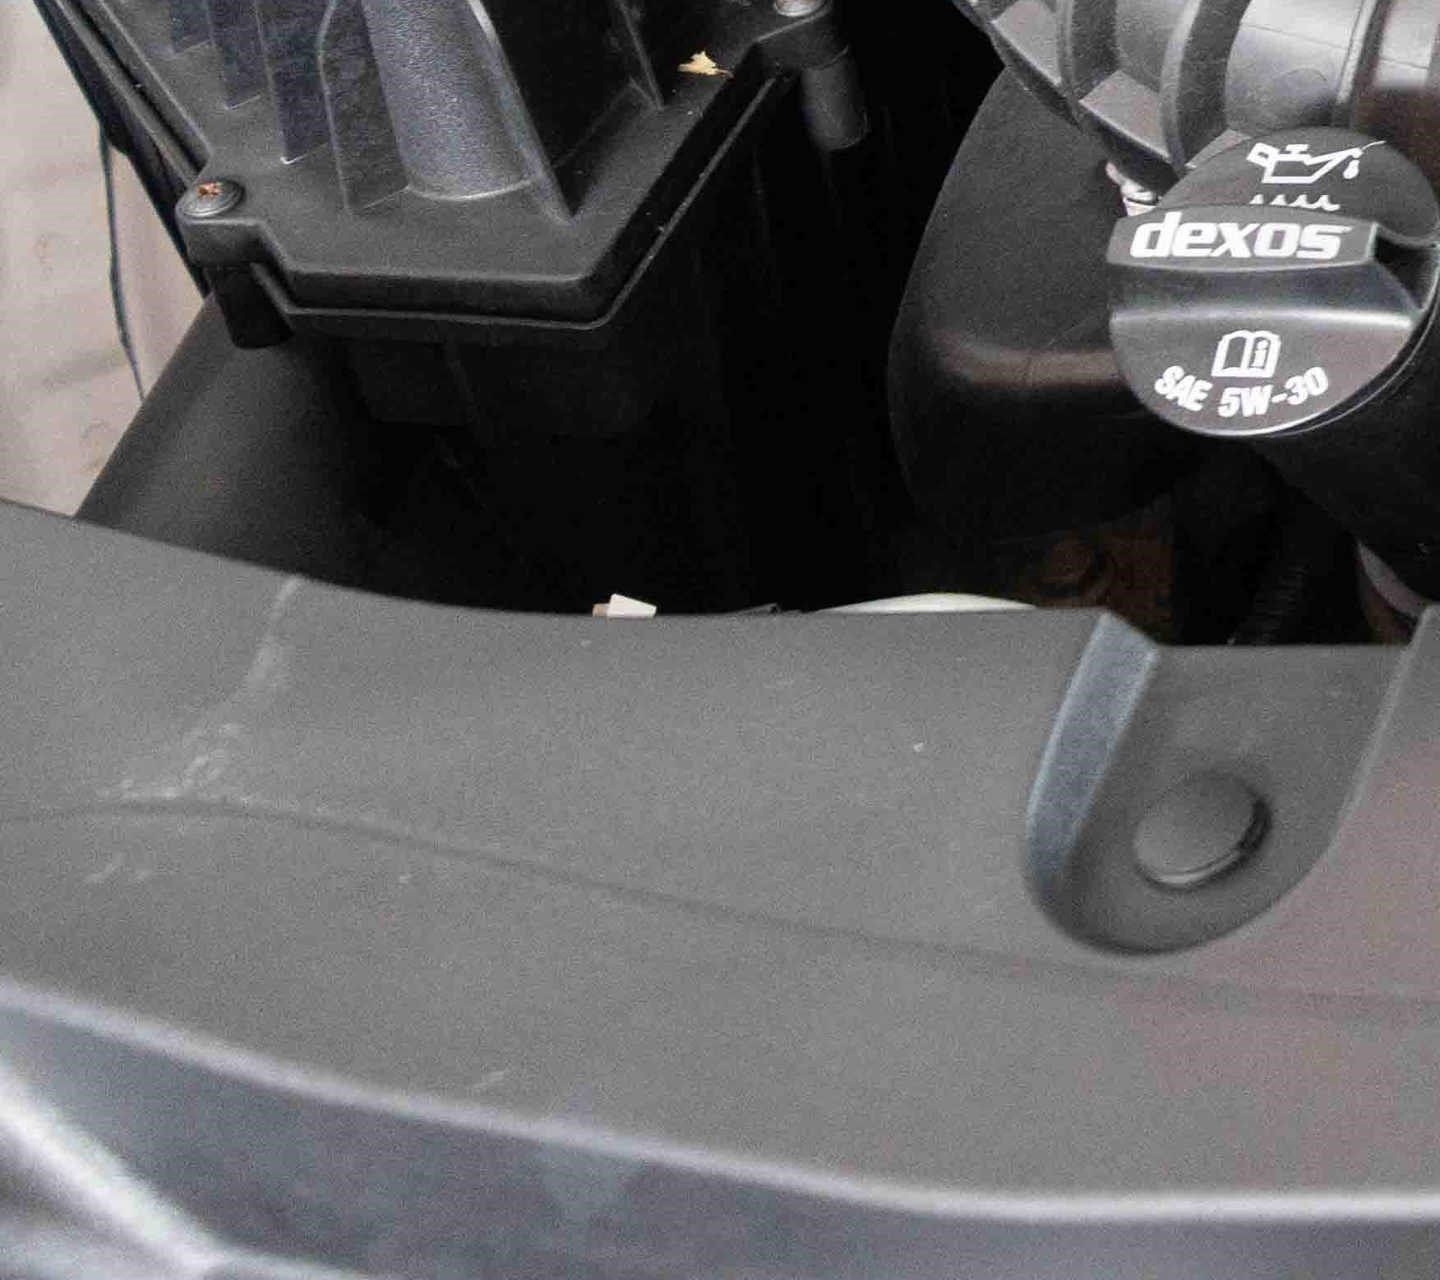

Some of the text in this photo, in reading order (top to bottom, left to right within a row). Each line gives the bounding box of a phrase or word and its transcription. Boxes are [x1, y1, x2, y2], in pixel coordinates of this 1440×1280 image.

[1130, 211, 1352, 260] dexos
[1153, 365, 1329, 418] SAE 5W-30
